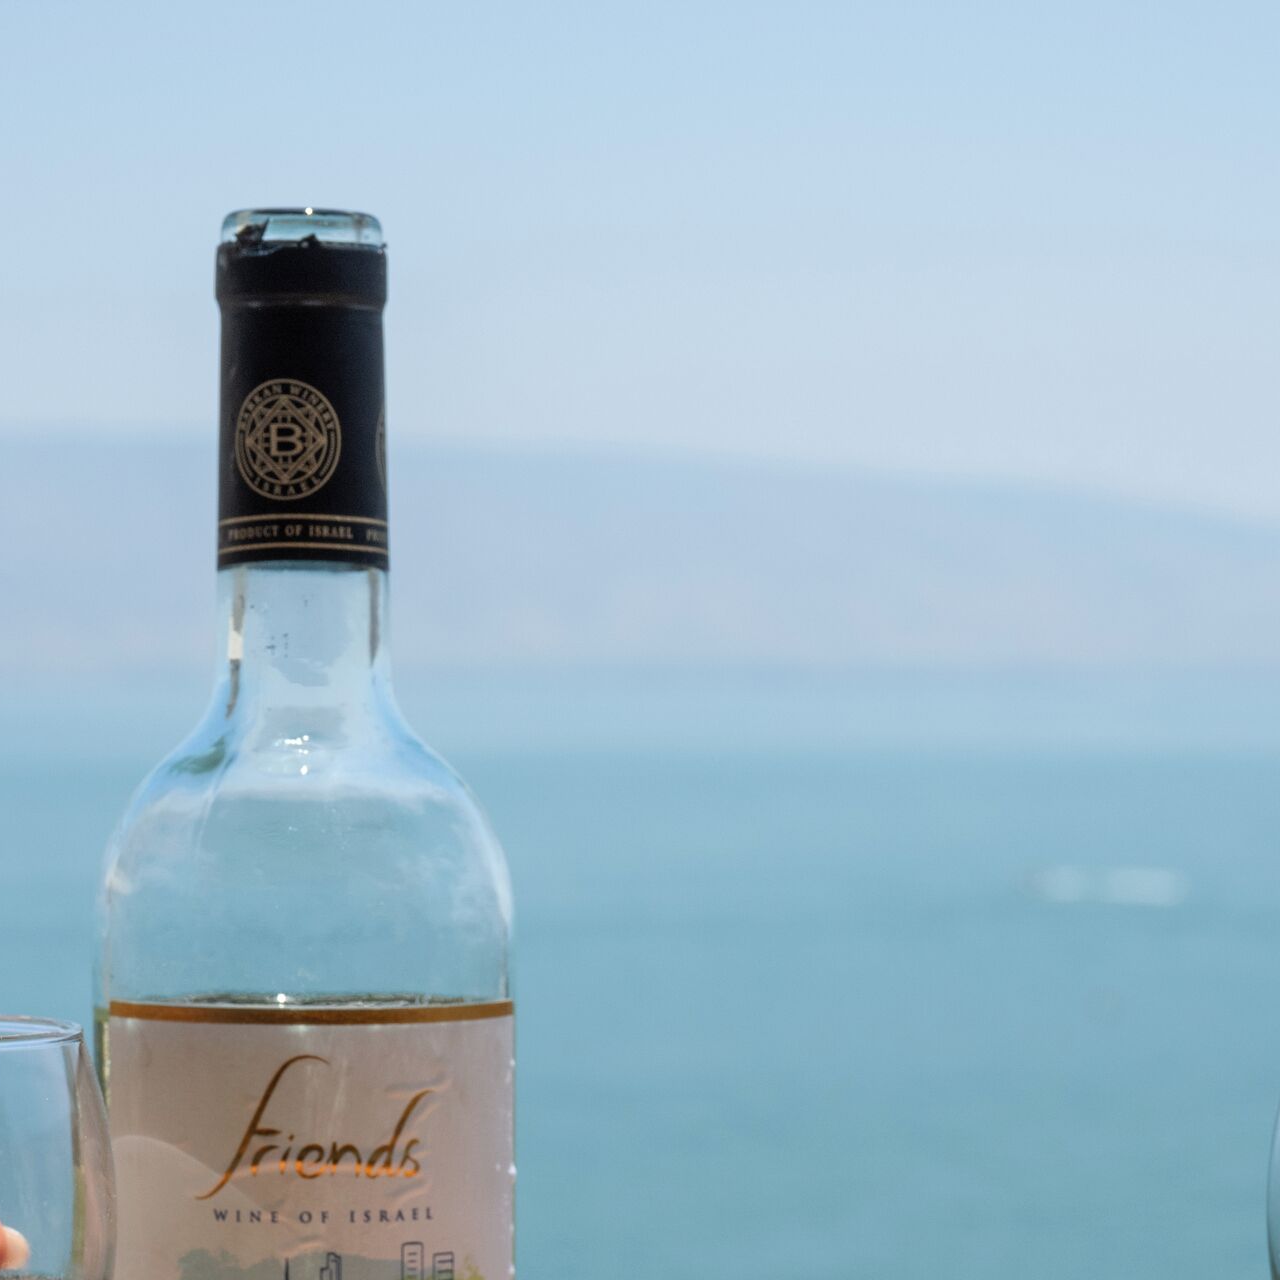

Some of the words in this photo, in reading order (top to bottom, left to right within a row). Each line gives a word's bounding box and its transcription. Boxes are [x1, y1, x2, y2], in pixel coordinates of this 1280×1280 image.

[290, 383, 336, 431] WINERY
[270, 422, 304, 457] B
[253, 476, 322, 497] ISRAEL
[228, 525, 280, 541] PRODUCT
[284, 524, 301, 537] OF
[308, 525, 354, 540] ISRAEL
[214, 1208, 280, 1224] WINE
[299, 1210, 330, 1224] OF
[350, 1206, 434, 1223] ISRAEL
